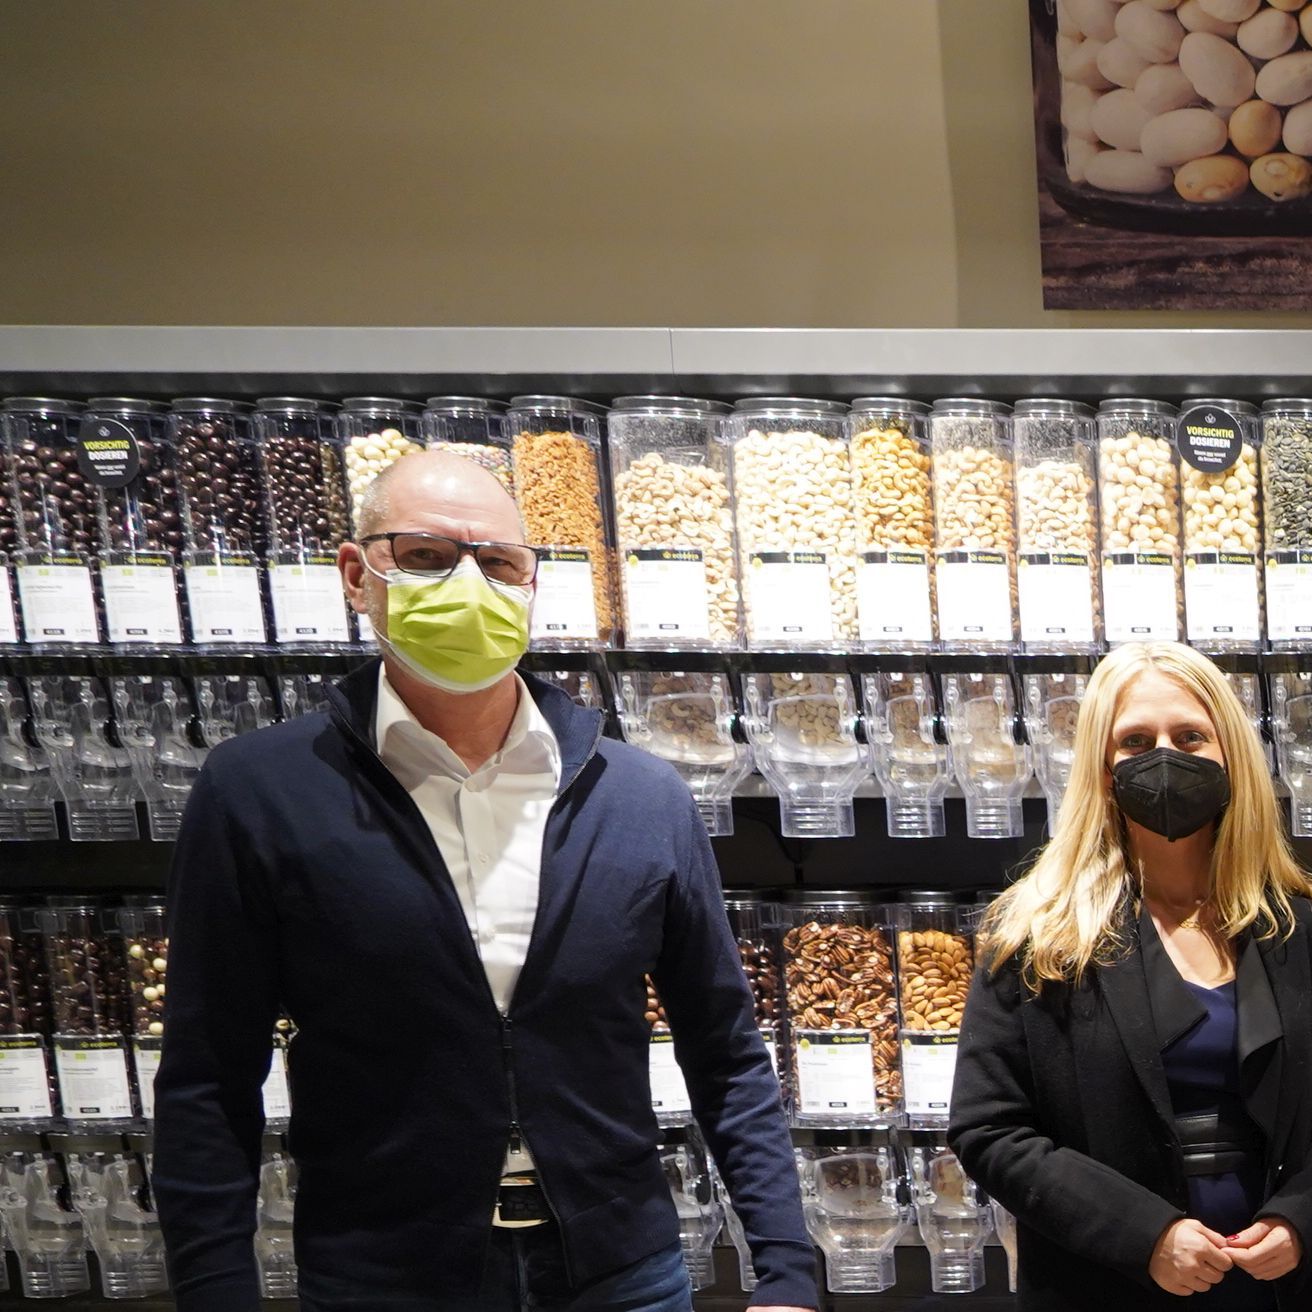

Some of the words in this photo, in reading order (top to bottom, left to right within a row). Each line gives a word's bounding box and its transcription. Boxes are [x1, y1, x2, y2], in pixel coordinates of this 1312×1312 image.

[1186, 425, 1235, 439] VORSICHTIG
[83, 440, 130, 450] VORSICHTIG
[1189, 436, 1231, 449] DOSIEREN
[88, 450, 129, 461] DOSIEREN
